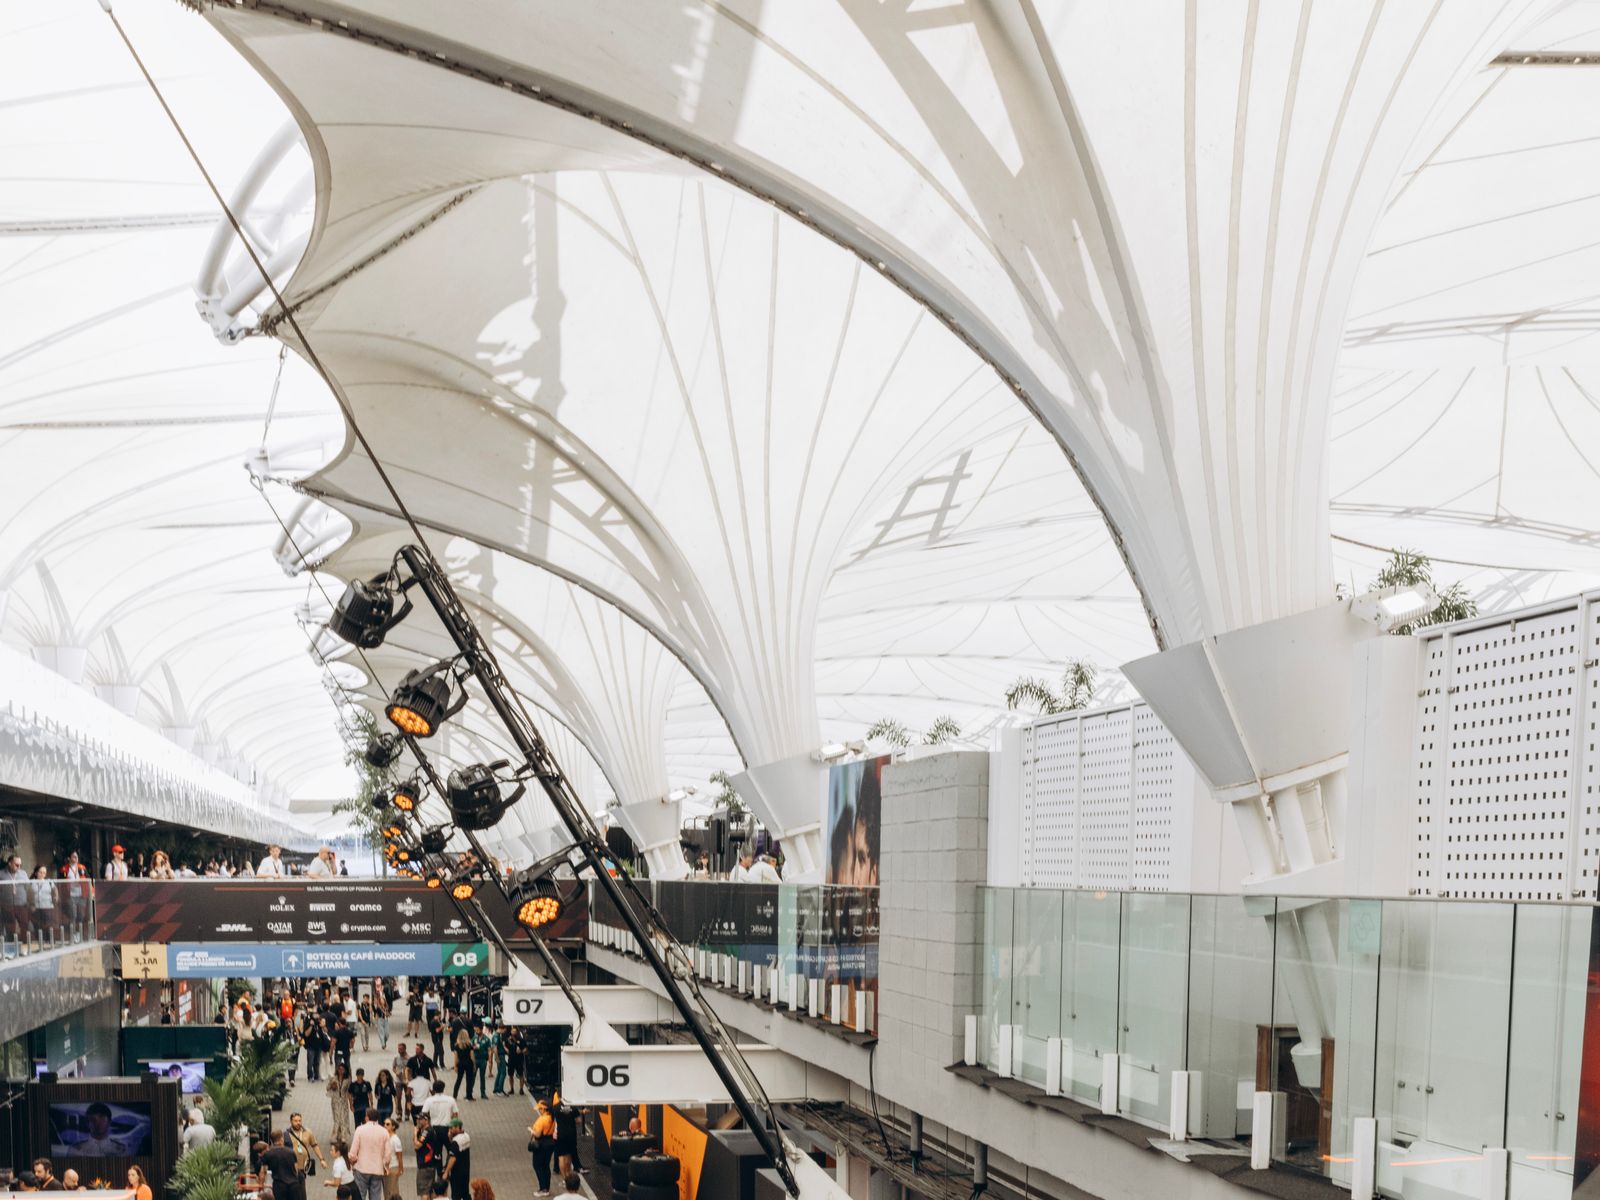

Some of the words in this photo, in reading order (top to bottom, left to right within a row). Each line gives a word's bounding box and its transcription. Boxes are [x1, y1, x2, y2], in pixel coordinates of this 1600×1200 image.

[269, 904, 295, 912] ROLEX
[267, 922, 292, 930] QATAR
[350, 924, 386, 932] crypto.com
[411, 923, 431, 931] MSC
[307, 952, 341, 960] BOTECO
[351, 950, 373, 960] CAFÉ
[374, 952, 416, 960] PADDOCK
[453, 952, 477, 967] 08
[307, 961, 350, 969] FRUTARIA
[516, 999, 543, 1014] 07
[586, 1064, 630, 1087] 06
